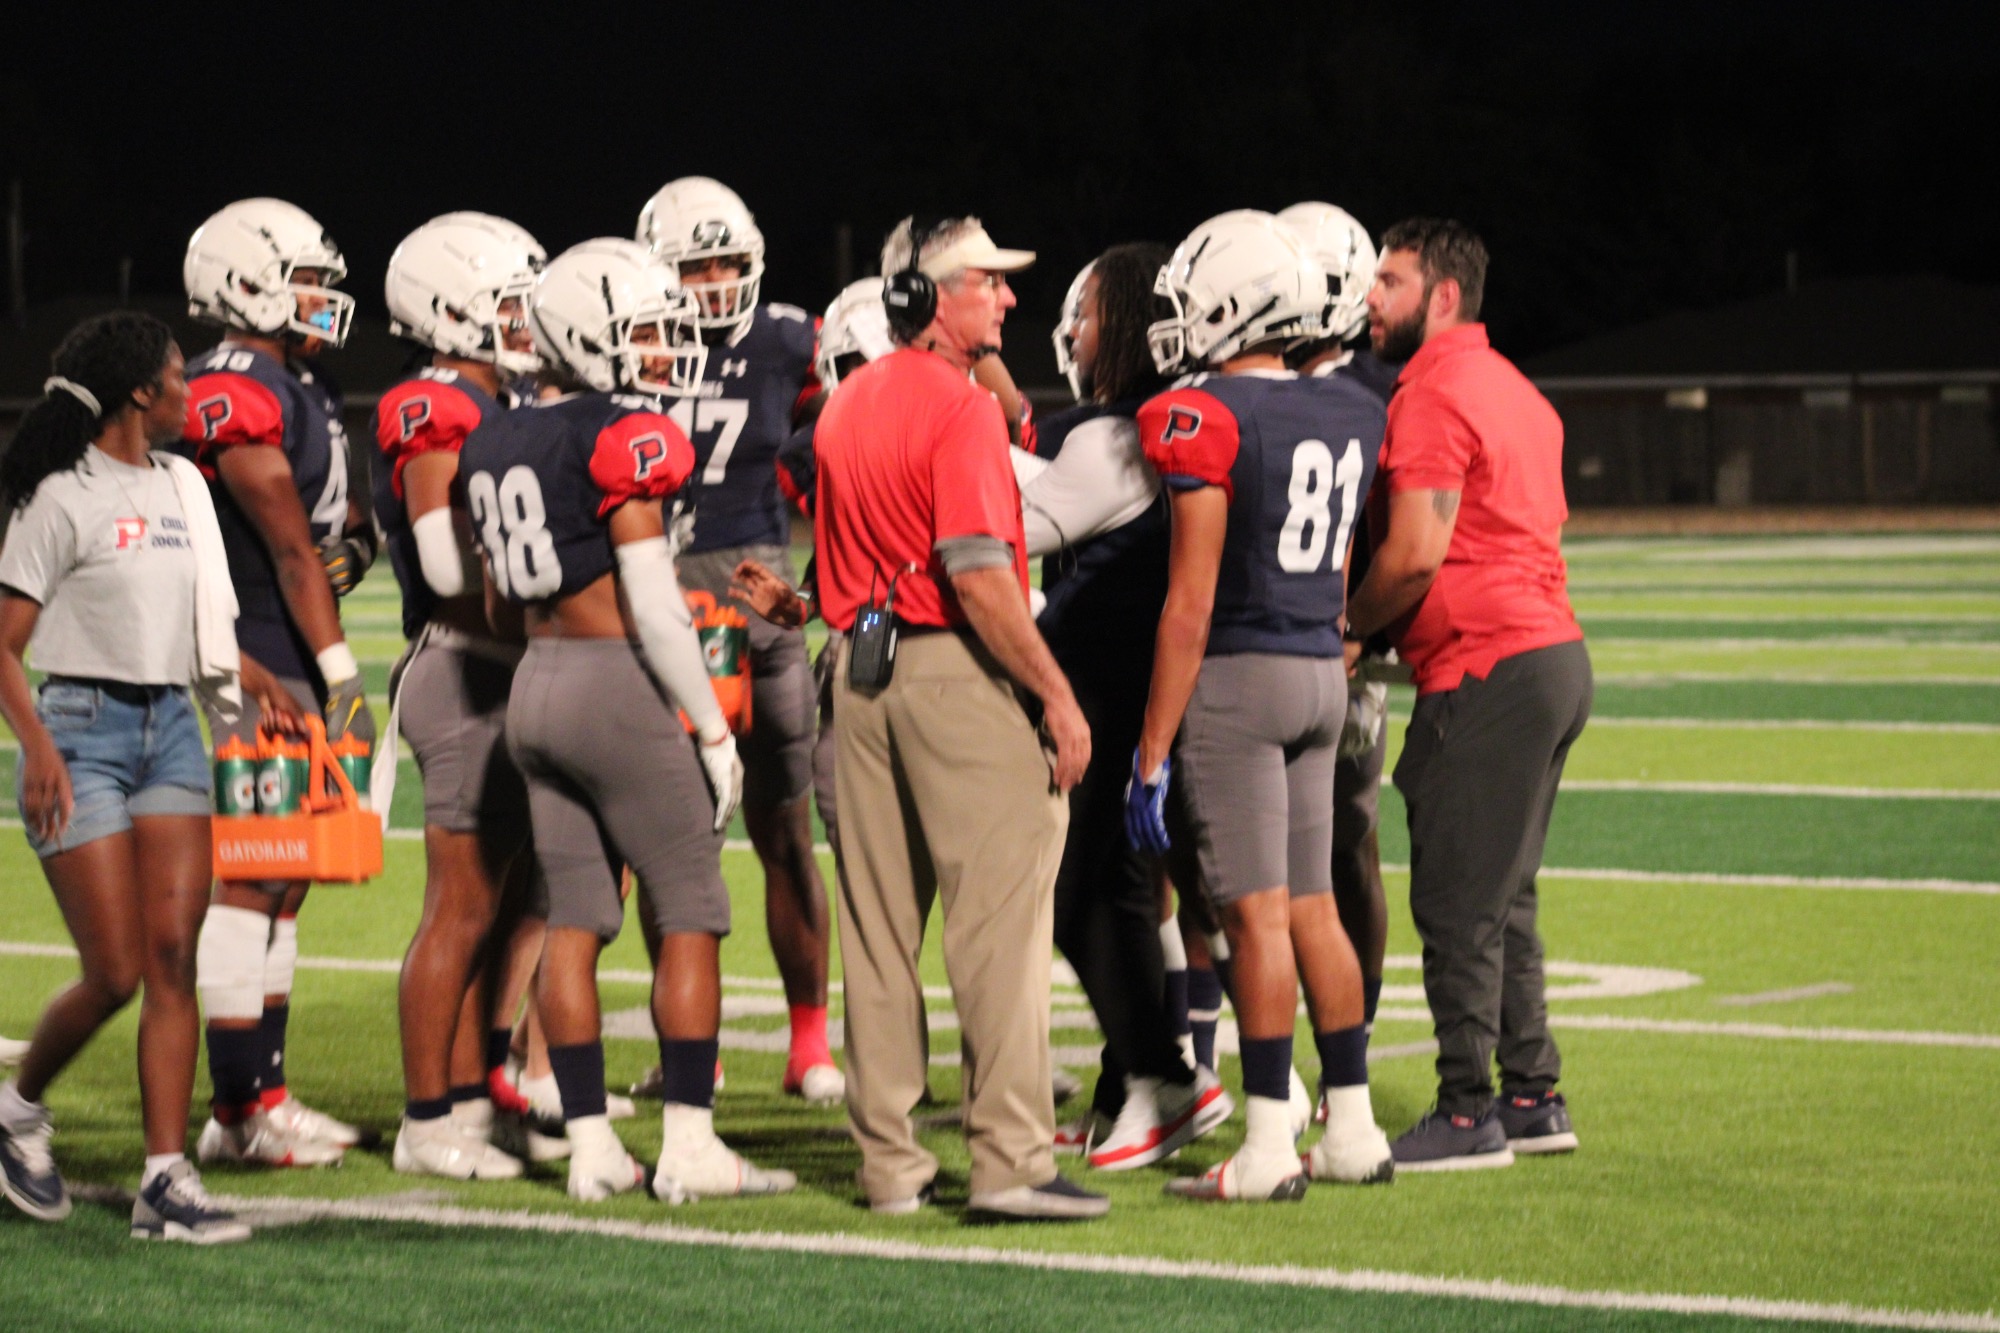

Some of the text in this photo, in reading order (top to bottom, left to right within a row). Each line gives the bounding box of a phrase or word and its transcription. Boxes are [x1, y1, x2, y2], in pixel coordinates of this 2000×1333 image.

[197, 392, 232, 441] P
[398, 394, 431, 444] P
[1160, 403, 1202, 444] P
[629, 431, 667, 482] P
[1277, 438, 1363, 573] 81
[115, 517, 146, 550] P
[468, 464, 563, 600] 38
[219, 839, 309, 862] GATORADE
